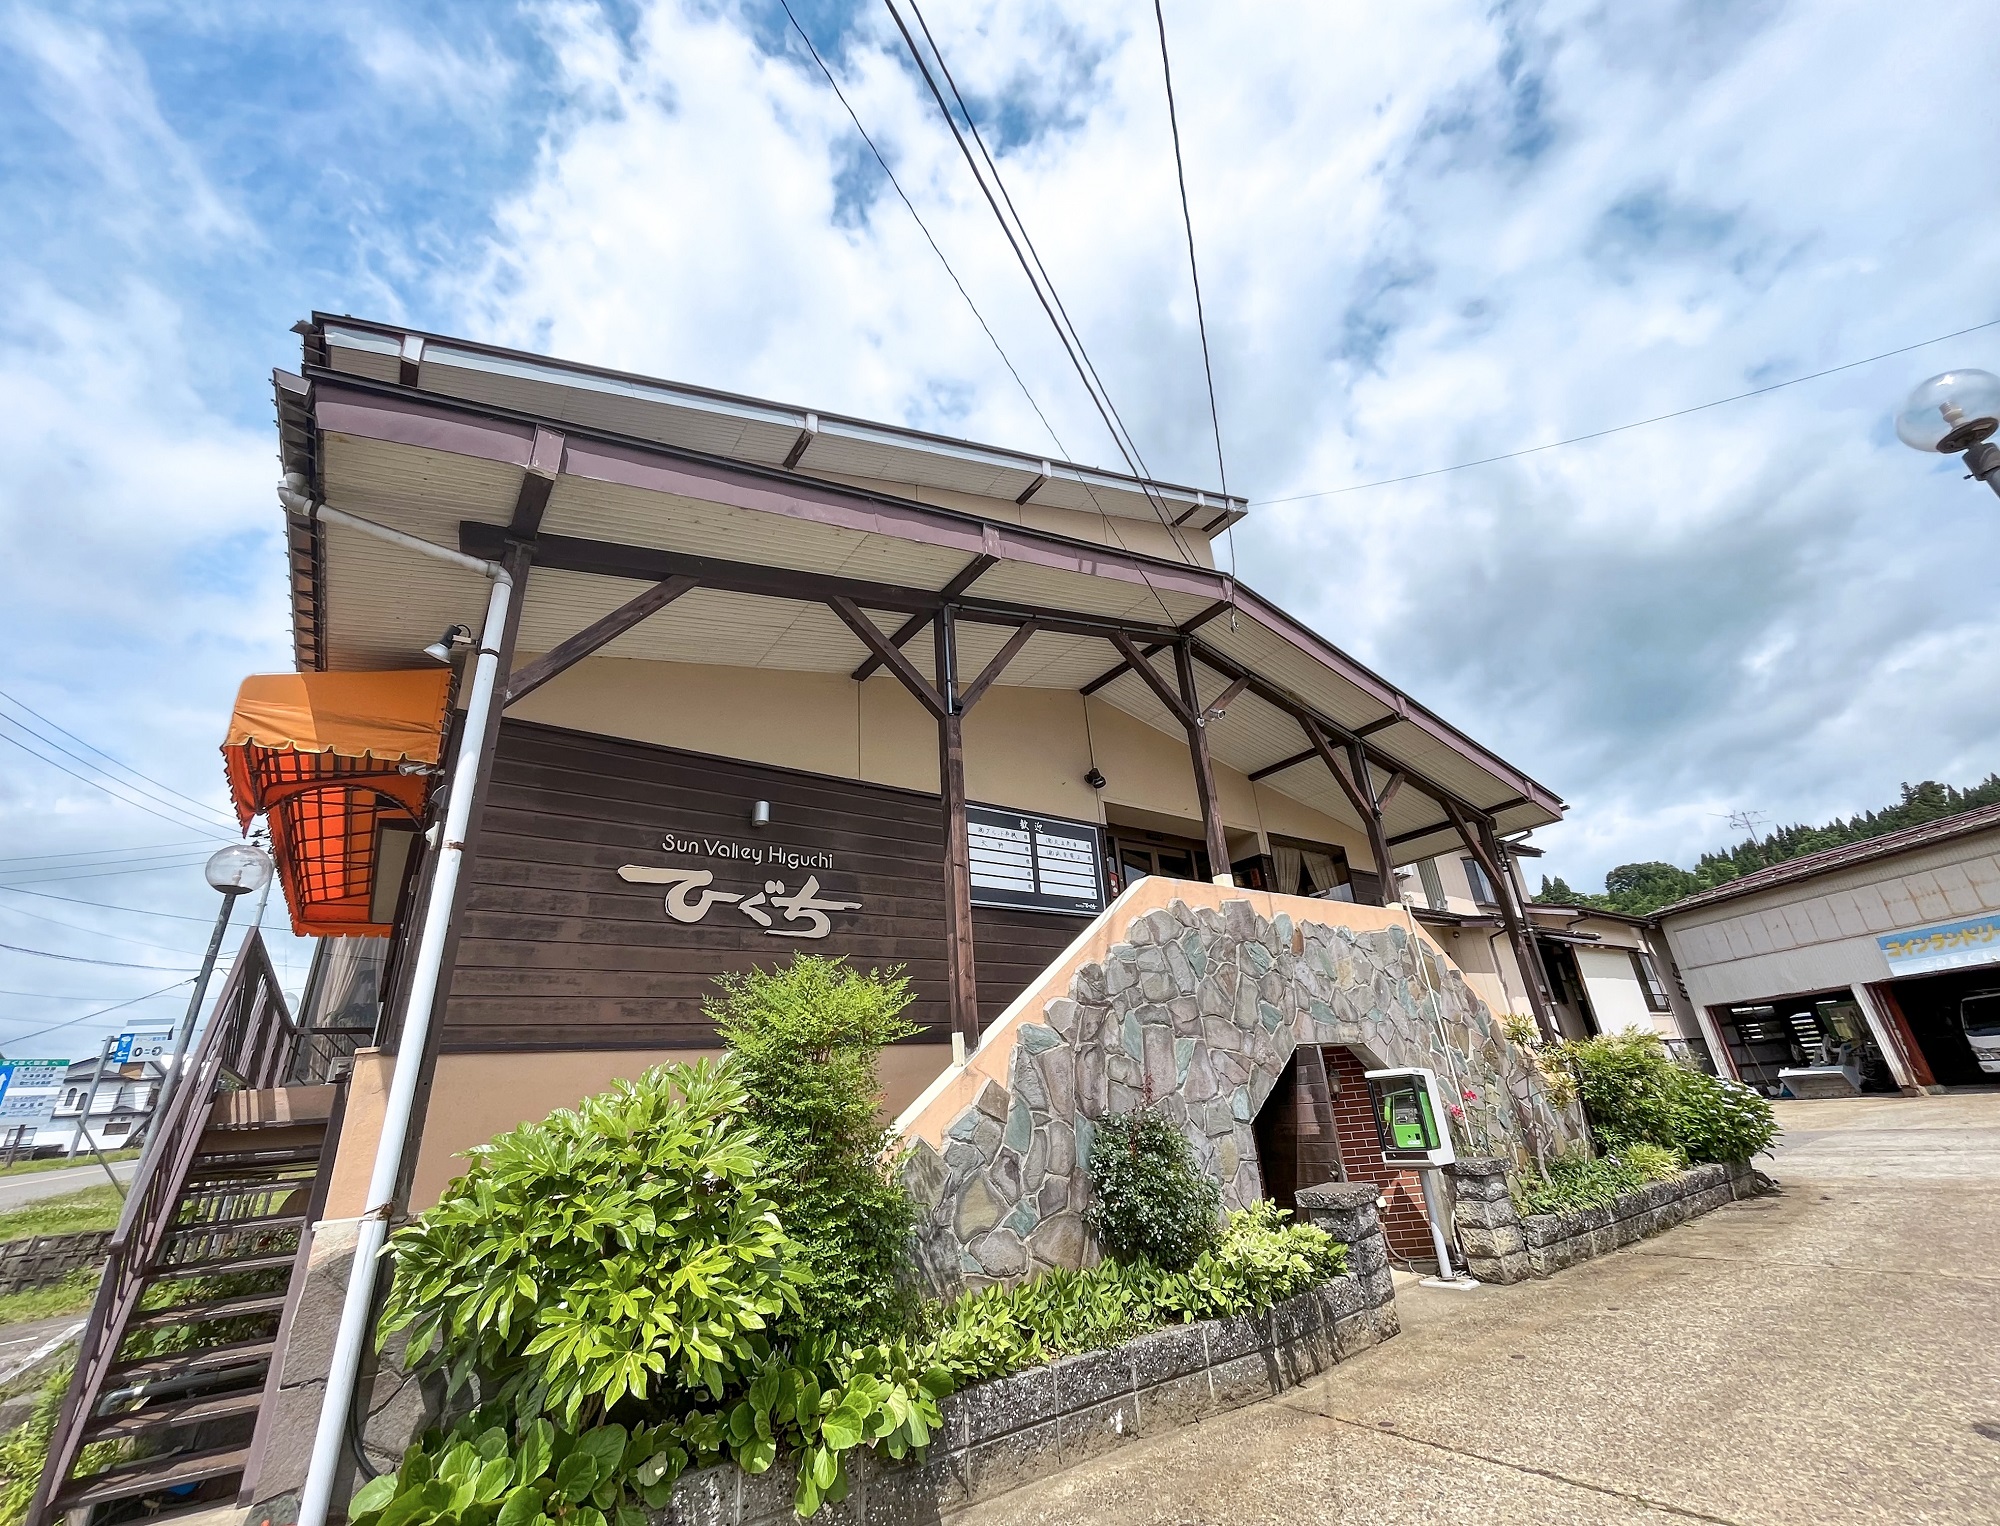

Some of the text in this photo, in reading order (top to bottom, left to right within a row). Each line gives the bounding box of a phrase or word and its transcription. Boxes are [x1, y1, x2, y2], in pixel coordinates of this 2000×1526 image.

[1020, 819, 1043, 833] 歓迎
[662, 833, 834, 870] Sun Valley Higuchi
[617, 865, 863, 939] ひぐち
